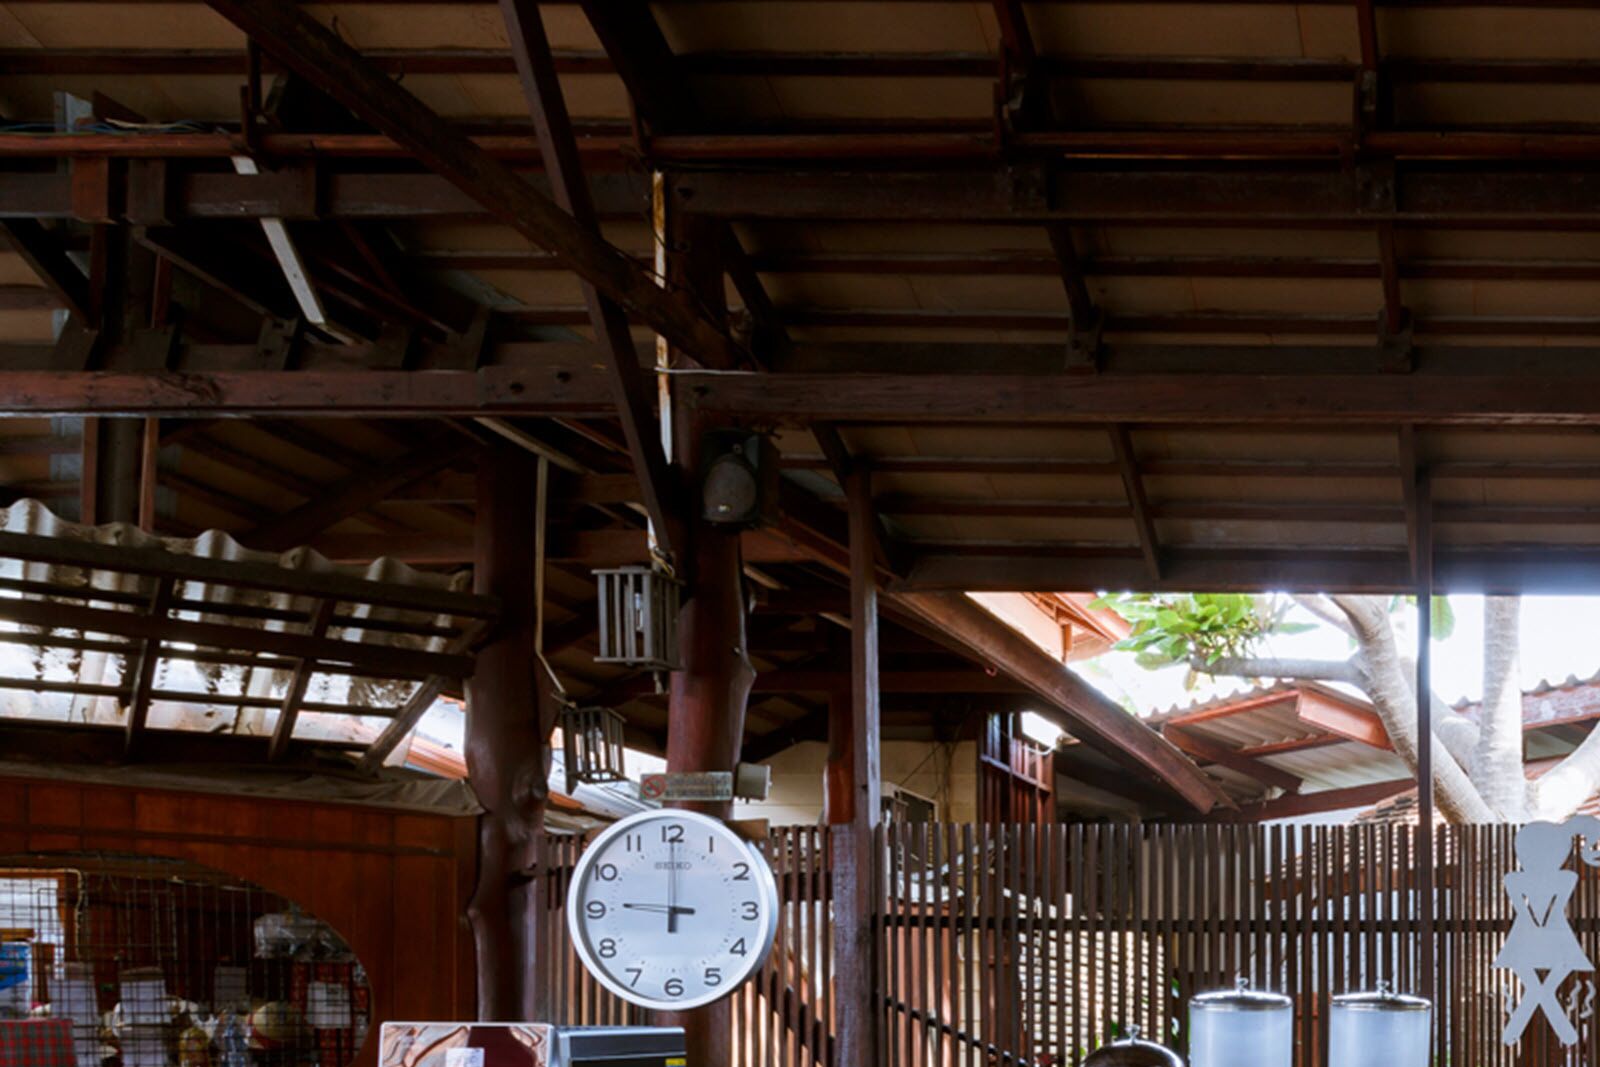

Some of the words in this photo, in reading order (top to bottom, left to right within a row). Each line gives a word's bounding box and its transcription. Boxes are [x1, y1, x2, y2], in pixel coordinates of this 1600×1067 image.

[626, 834, 641, 852] 11
[661, 825, 684, 843] 12
[594, 863, 617, 881] 10
[732, 862, 749, 880] 2
[586, 900, 606, 919] 9
[741, 901, 759, 921] 3
[599, 938, 617, 958] 8
[729, 937, 747, 957] 4
[625, 968, 643, 987] 7
[703, 968, 722, 987] 5
[664, 978, 684, 997] 6
